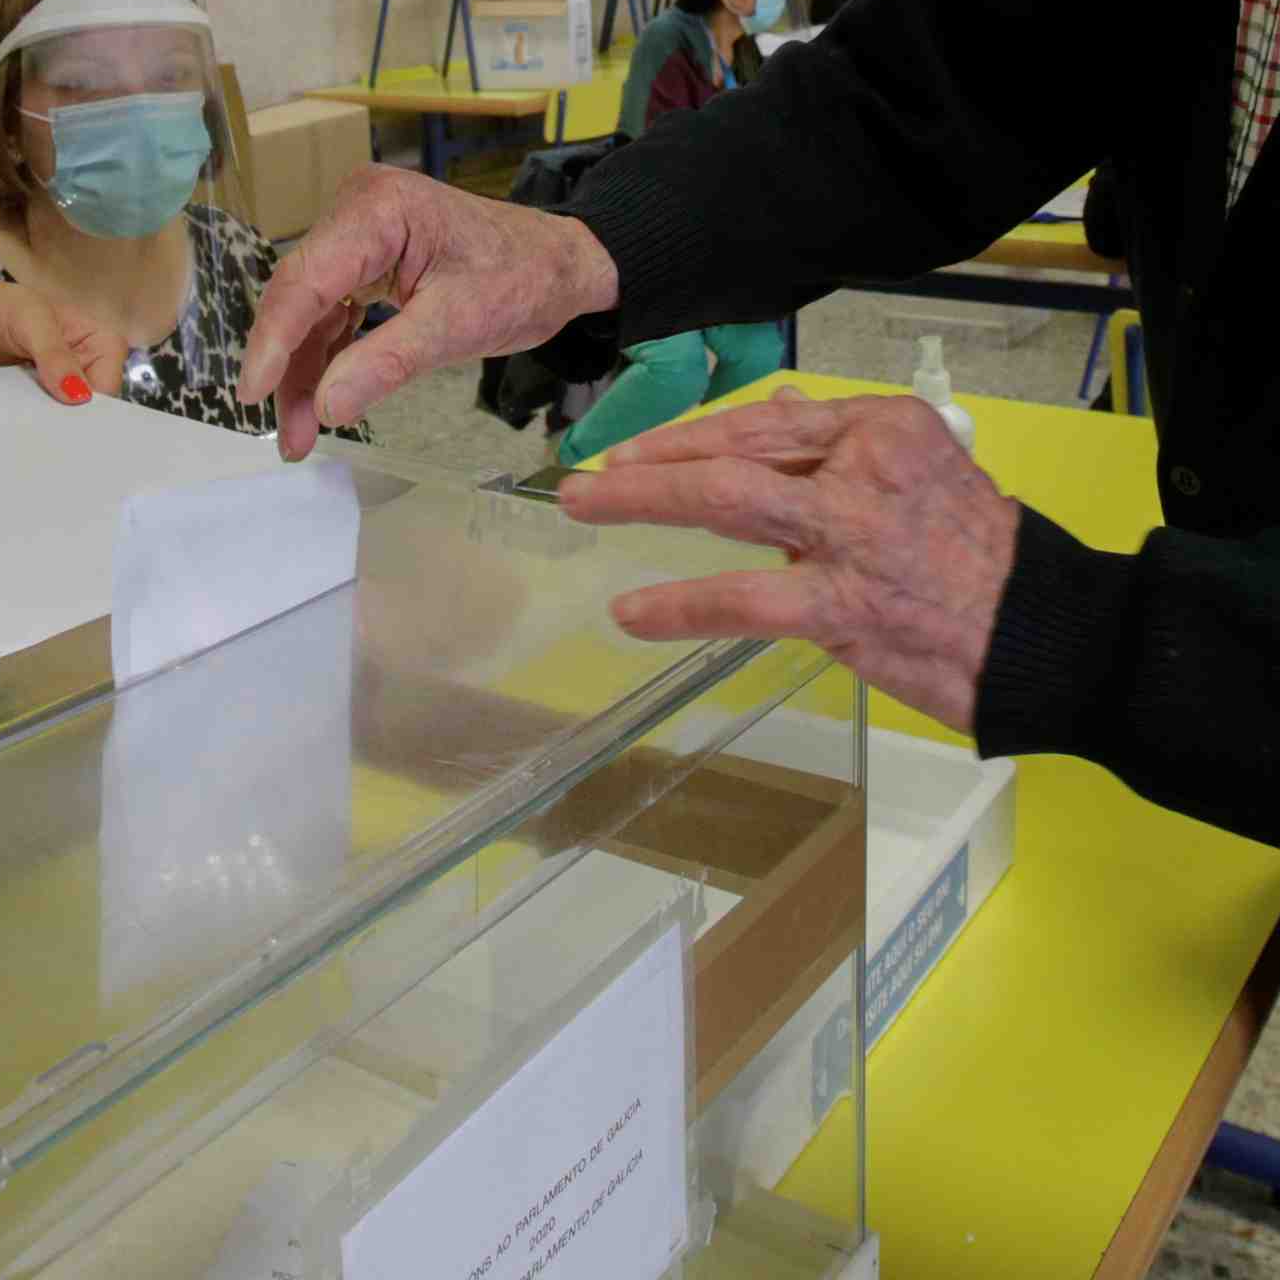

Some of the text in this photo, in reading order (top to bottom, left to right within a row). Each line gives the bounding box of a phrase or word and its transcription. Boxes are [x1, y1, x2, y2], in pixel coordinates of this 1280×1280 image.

[514, 1157, 587, 1237] PARLAMENTO
[589, 1136, 604, 1162] DE
[606, 1097, 642, 1143] GALICIA
[591, 1189, 606, 1215] DE
[528, 1215, 557, 1253] 2020
